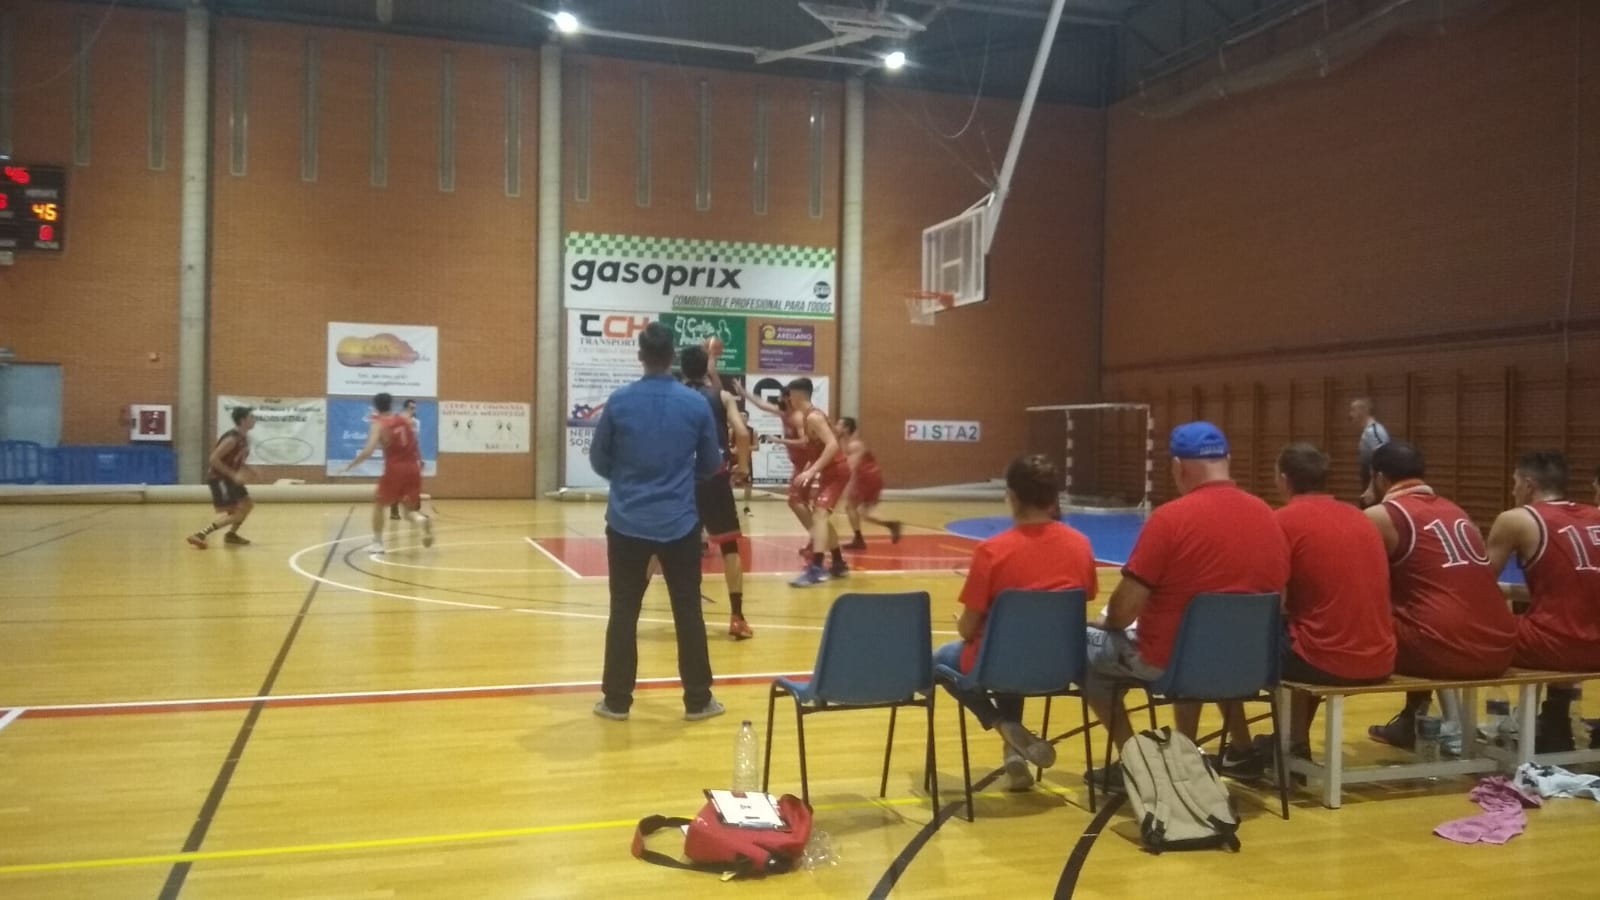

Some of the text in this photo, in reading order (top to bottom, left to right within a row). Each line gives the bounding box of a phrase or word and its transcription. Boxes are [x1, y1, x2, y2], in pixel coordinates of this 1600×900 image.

[31, 203, 57, 221] 45
[570, 254, 742, 296] gasoprix
[672, 294, 831, 313] COMBUSTIBLE PROFESIONAL PARA TODOS
[579, 337, 640, 347] TRANSPORT
[569, 438, 591, 447] SOR
[1423, 518, 1491, 568] 10
